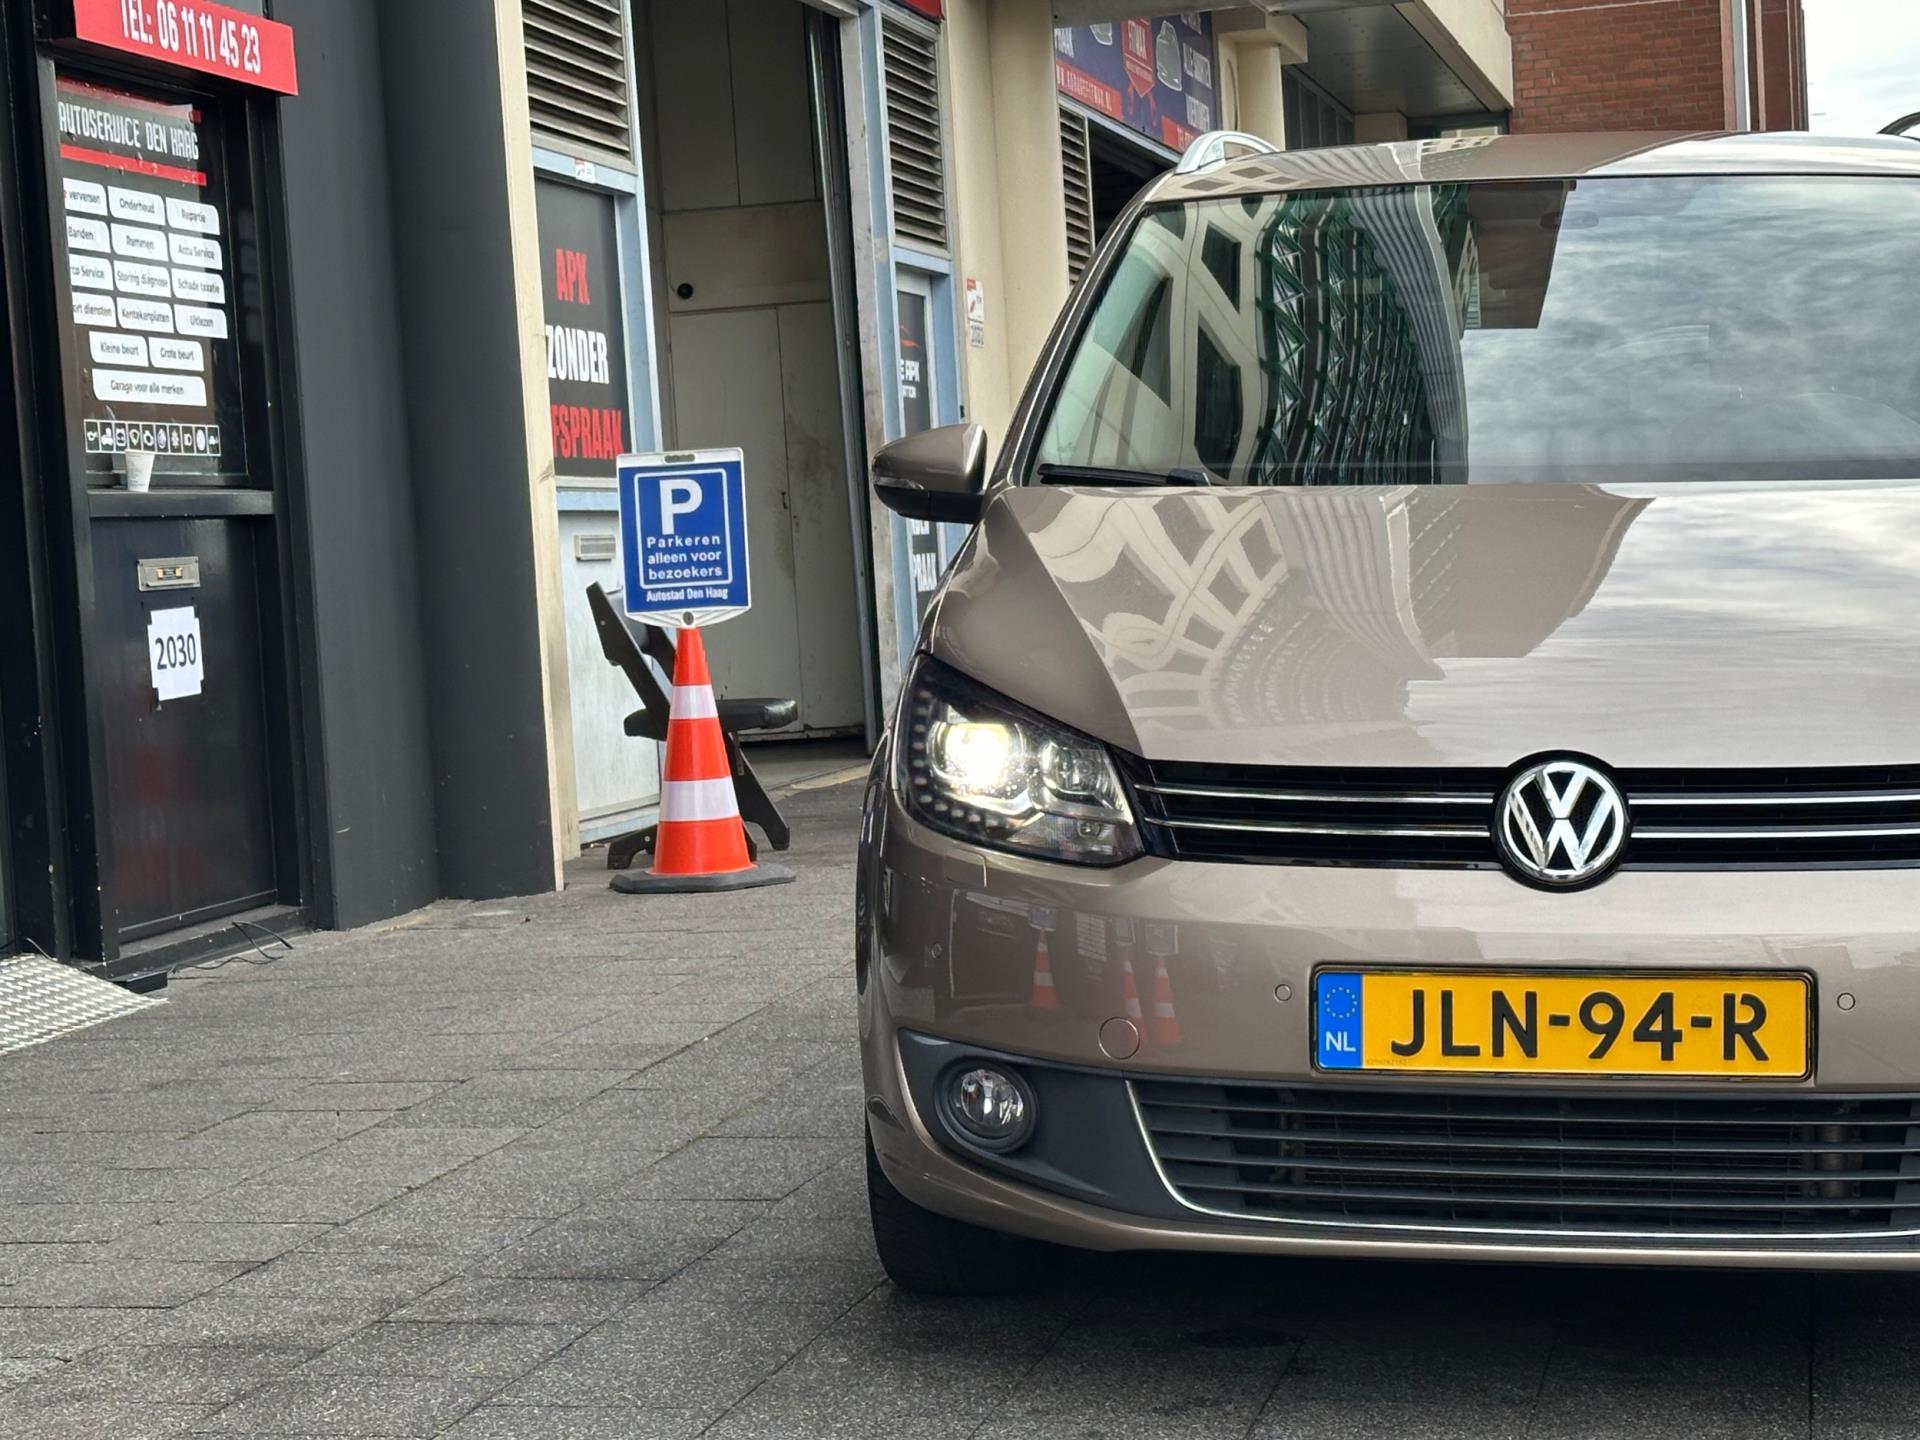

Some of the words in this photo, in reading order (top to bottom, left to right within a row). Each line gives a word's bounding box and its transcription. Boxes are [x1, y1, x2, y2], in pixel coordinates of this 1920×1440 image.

[121, 0, 153, 45] TEL:
[156, 0, 179, 52] 06
[181, 6, 198, 57] 11
[199, 12, 216, 63] 11
[219, 18, 240, 69] 45
[241, 23, 261, 74] 23
[58, 101, 141, 148] AUTOSERVICE
[145, 121, 167, 154] DEN
[170, 127, 199, 160] HAAG
[68, 225, 94, 241] Banden
[81, 264, 105, 279] Service
[555, 247, 590, 305] APK
[545, 323, 610, 385] ZONDER
[134, 383, 148, 393] voor
[149, 381, 160, 394] alle
[160, 383, 184, 396] merken
[659, 478, 703, 535] P
[646, 534, 721, 549] Parkeren
[647, 552, 688, 565] alleen
[690, 551, 722, 562] voor
[648, 565, 723, 580] bezoekers
[646, 588, 685, 602] Autostad
[686, 588, 704, 599] Den
[705, 586, 728, 600] Haag
[154, 632, 197, 671] 2030
[1325, 1030, 1357, 1053] NL
[1390, 988, 1769, 1062] JLN-94-R
